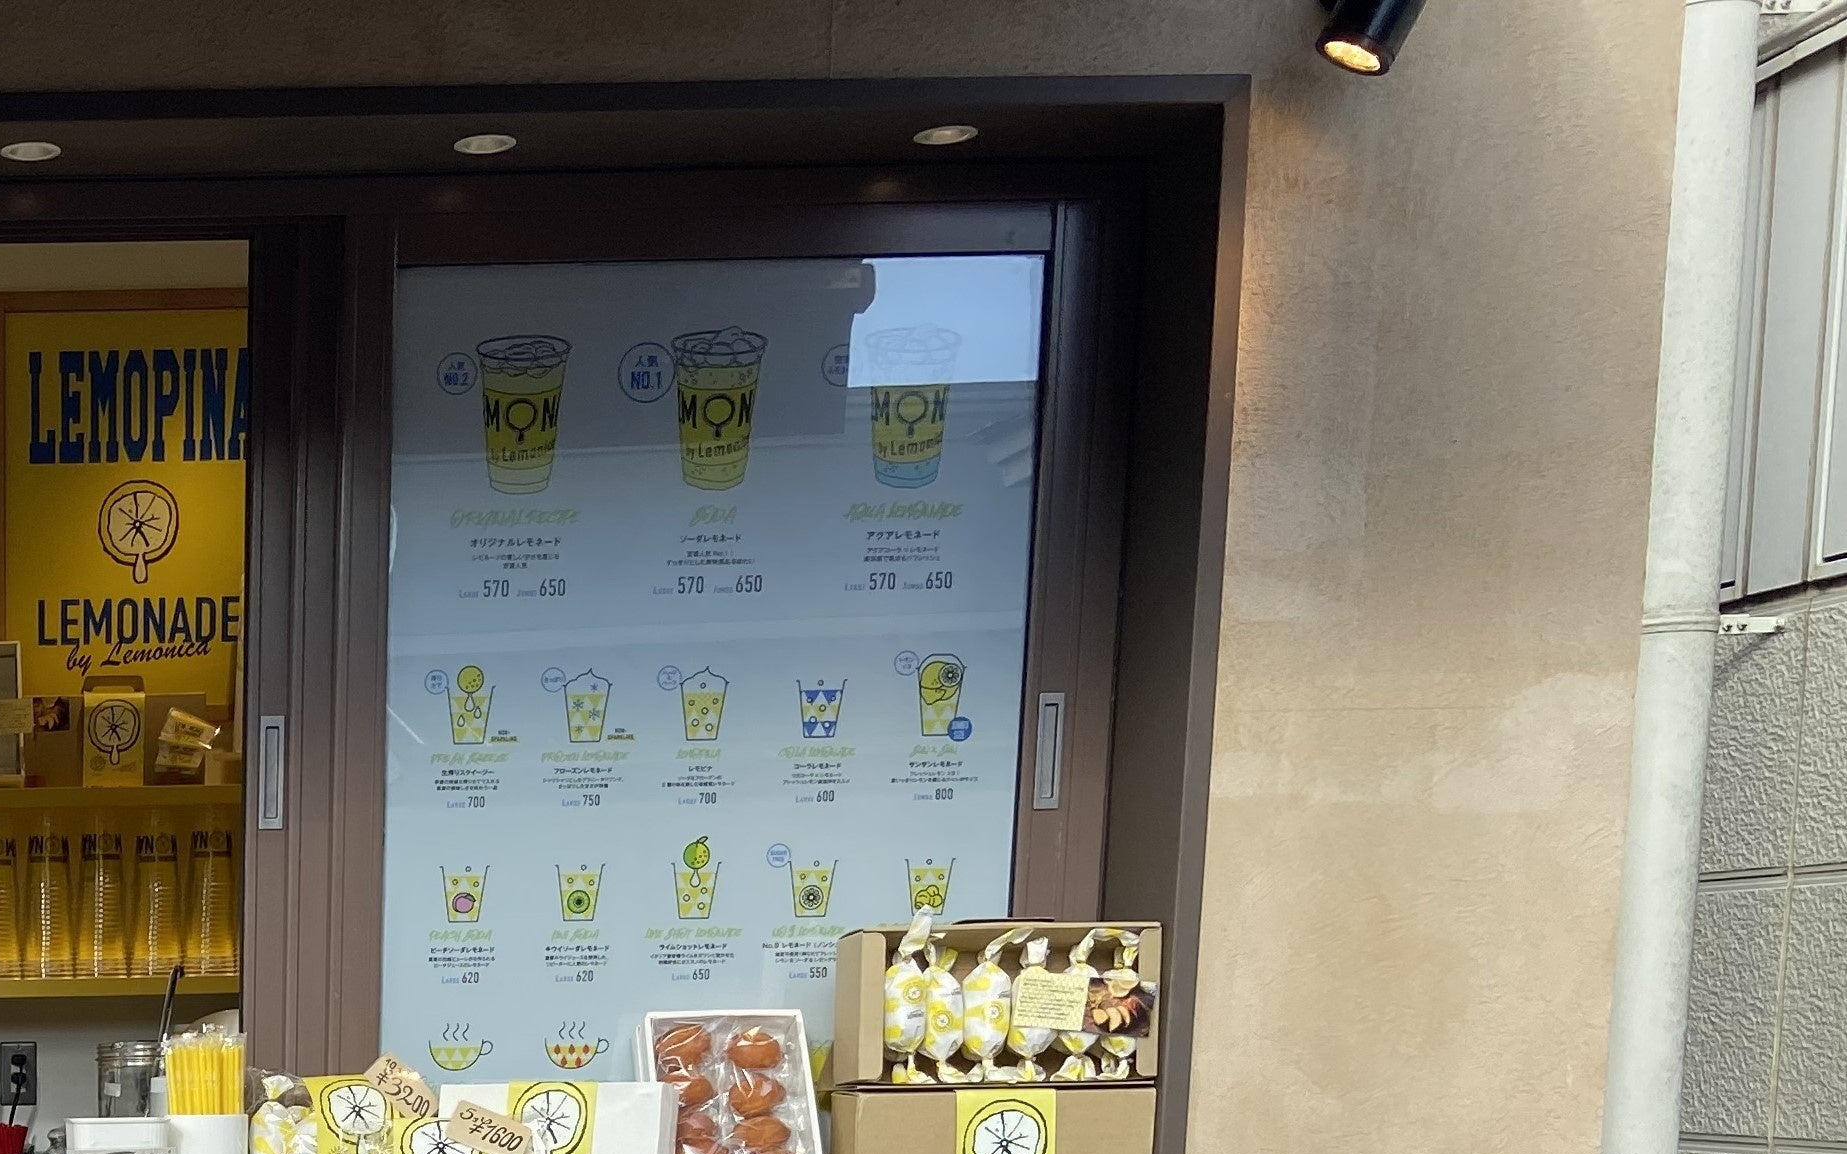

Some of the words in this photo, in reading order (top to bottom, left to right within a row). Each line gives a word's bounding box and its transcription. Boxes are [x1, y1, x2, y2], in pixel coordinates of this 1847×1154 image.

[630, 371, 662, 390] NO.1
[866, 529, 941, 541] アクアレモネード
[470, 536, 562, 548] オリジナルレモネード
[483, 578, 510, 597] 570
[539, 577, 566, 597] 650
[677, 575, 705, 595] 570
[735, 574, 763, 593] 650
[868, 572, 896, 591] 570
[925, 571, 953, 590] 650
[38, 595, 241, 646] LEMONADE
[66, 644, 92, 676] by
[100, 640, 212, 668] Lemonica
[553, 767, 613, 775] フローズンレモネード
[793, 762, 842, 770] コーラレモネード
[582, 794, 601, 807] 750
[698, 792, 717, 805] 700
[816, 790, 835, 803] 600
[934, 788, 954, 801] 800
[467, 796, 486, 809] 700
[430, 946, 496, 954] ピーチソーダレモネード
[545, 945, 610, 953] キウイソーダレモネード
[659, 943, 728, 951] ライムショットレモネード
[461, 972, 480, 984] 620
[576, 970, 594, 983] 620
[692, 969, 711, 981] 650
[809, 966, 828, 979] 550
[469, 1116, 524, 1152] ¥1600
